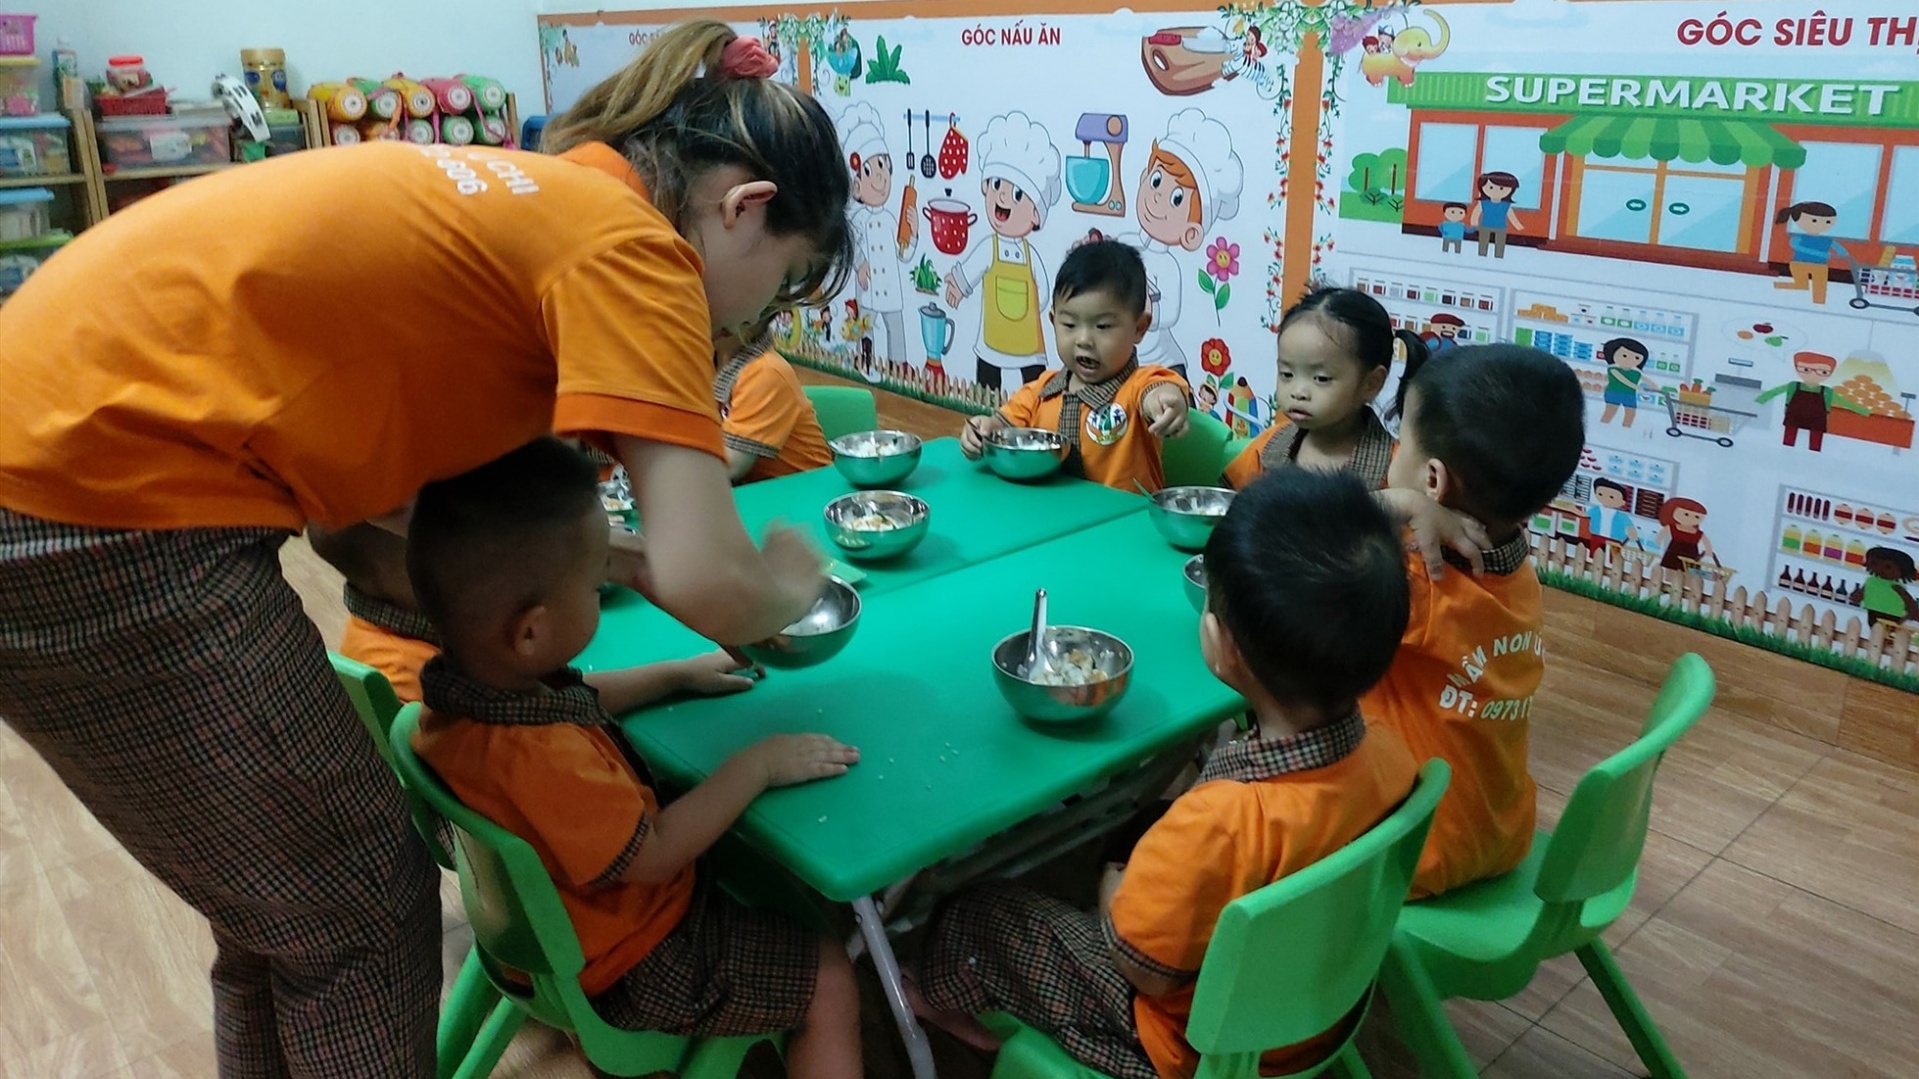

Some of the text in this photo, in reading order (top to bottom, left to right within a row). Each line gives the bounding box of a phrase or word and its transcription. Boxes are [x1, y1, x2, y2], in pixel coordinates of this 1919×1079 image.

[961, 19, 1060, 46] GÓC NẤU ĂN
[1677, 10, 1919, 55] GÓC SIÊU TH
[1485, 75, 1901, 116] SUPERMARKET
[1493, 630, 1533, 657] NON
[1439, 684, 1478, 718] ĐT:
